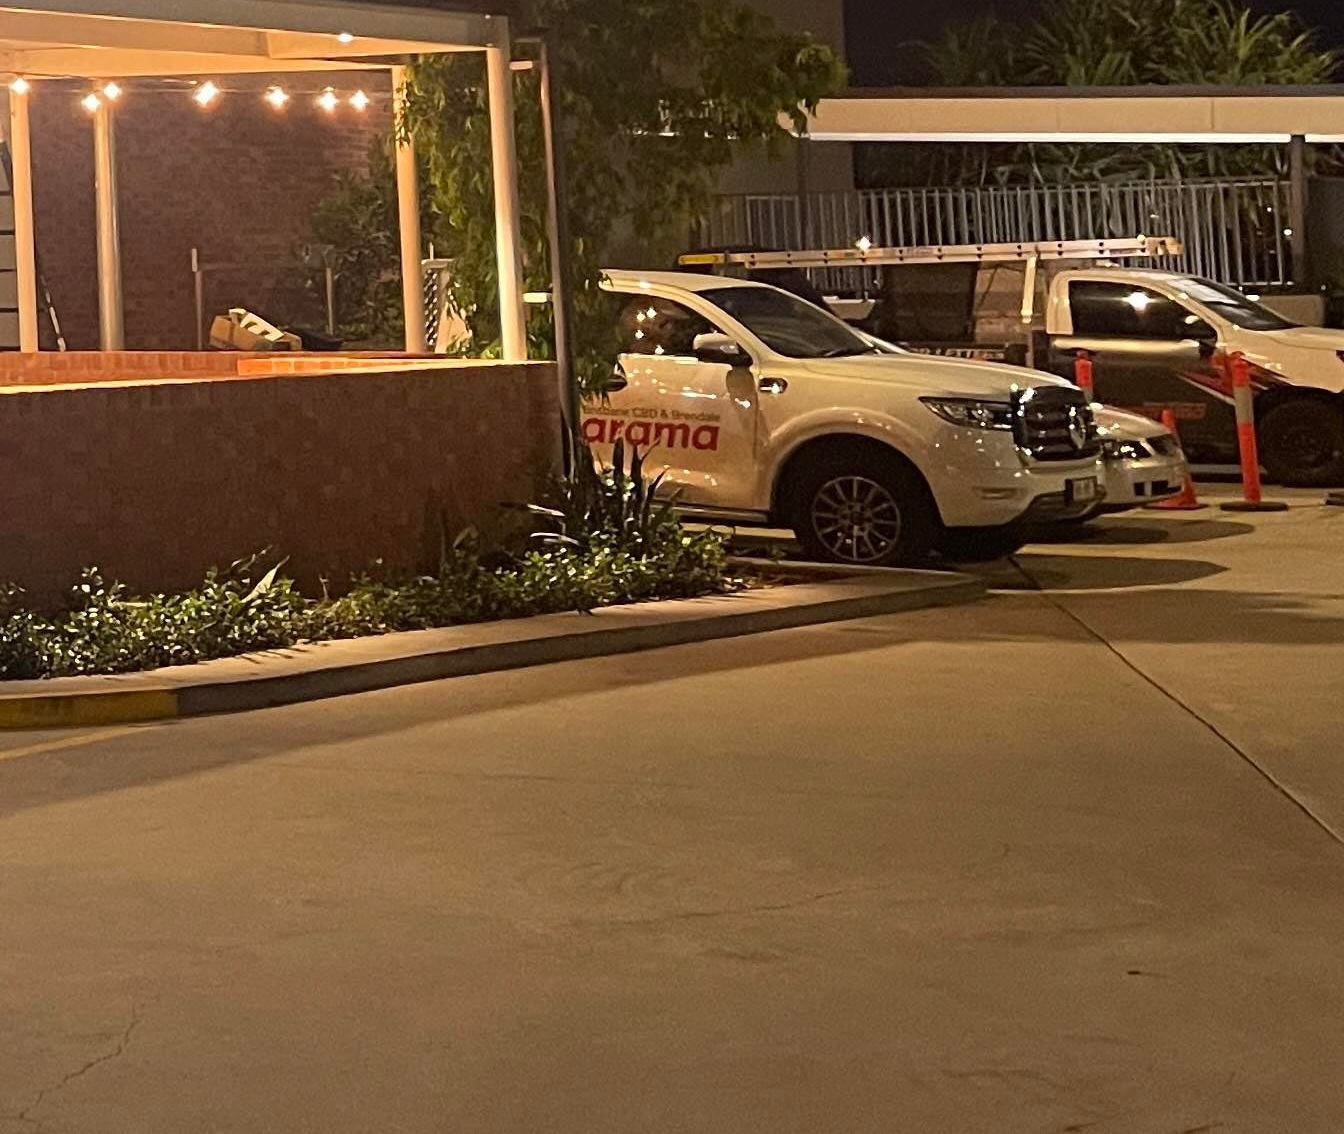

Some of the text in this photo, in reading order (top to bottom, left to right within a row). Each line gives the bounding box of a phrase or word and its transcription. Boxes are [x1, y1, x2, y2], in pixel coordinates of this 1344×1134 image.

[632, 407, 658, 419] CBD
[660, 409, 669, 419] &
[582, 417, 720, 451] arama
